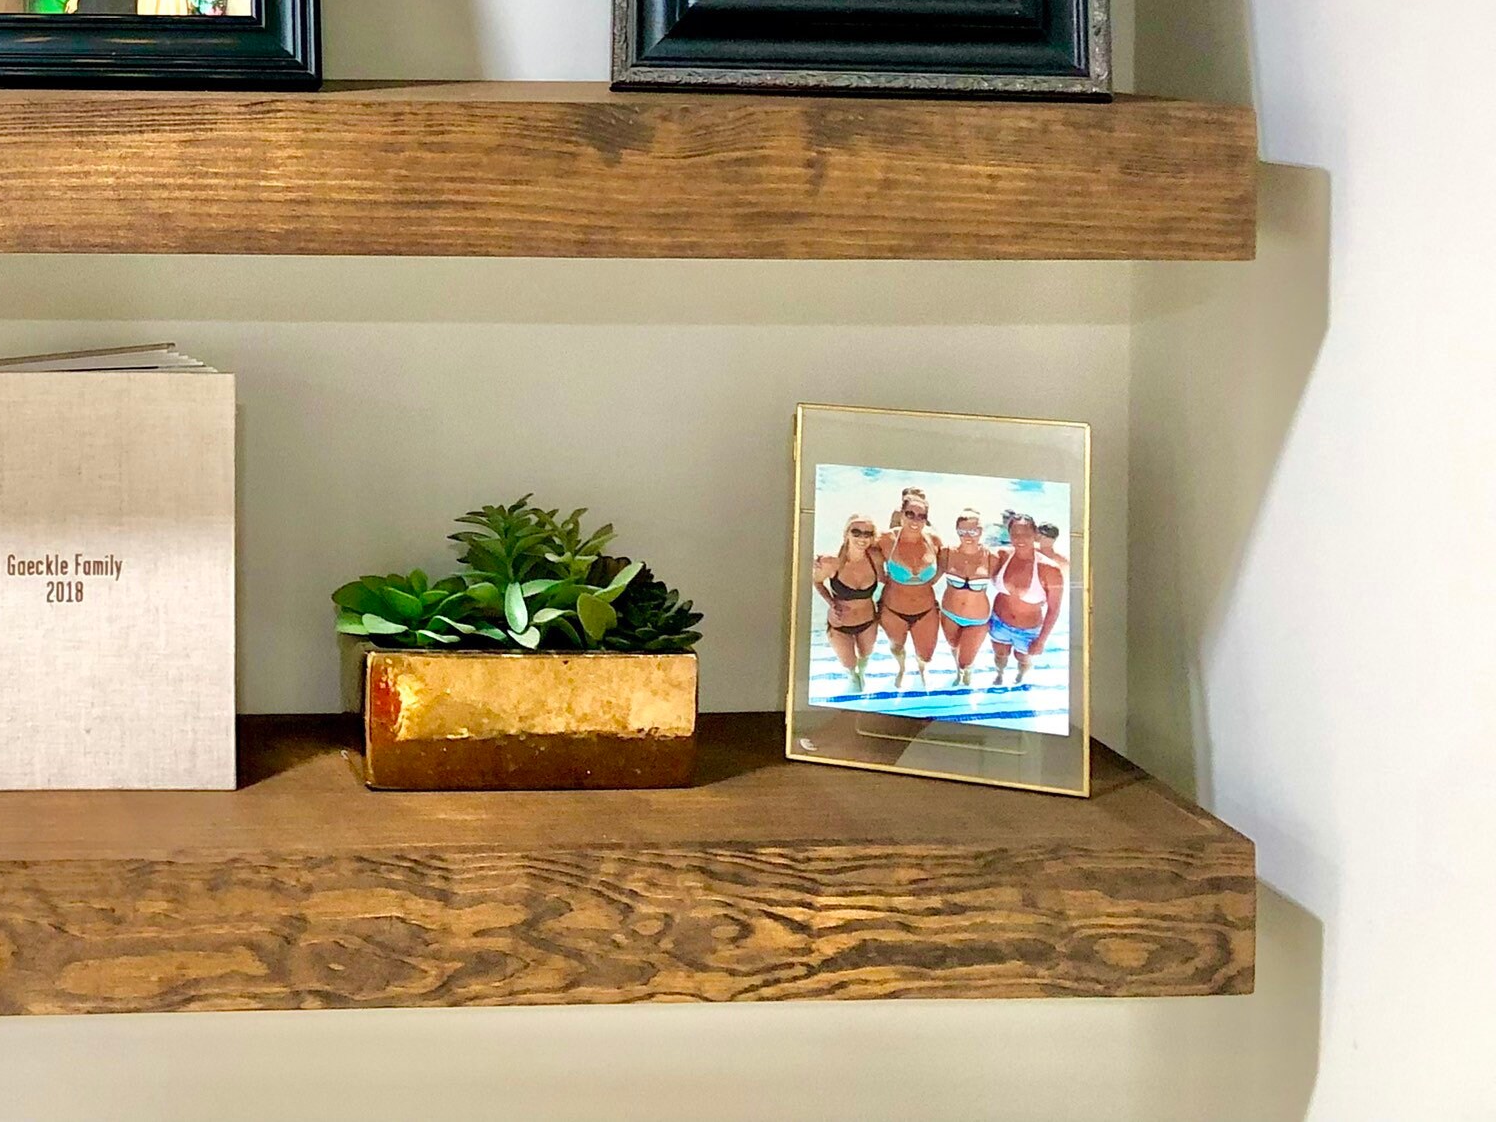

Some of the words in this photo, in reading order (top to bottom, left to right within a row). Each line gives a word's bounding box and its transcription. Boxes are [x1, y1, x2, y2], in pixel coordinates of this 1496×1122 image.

[7, 554, 68, 576] Gaeckle
[75, 553, 122, 581] Family
[46, 581, 84, 603] 2018
